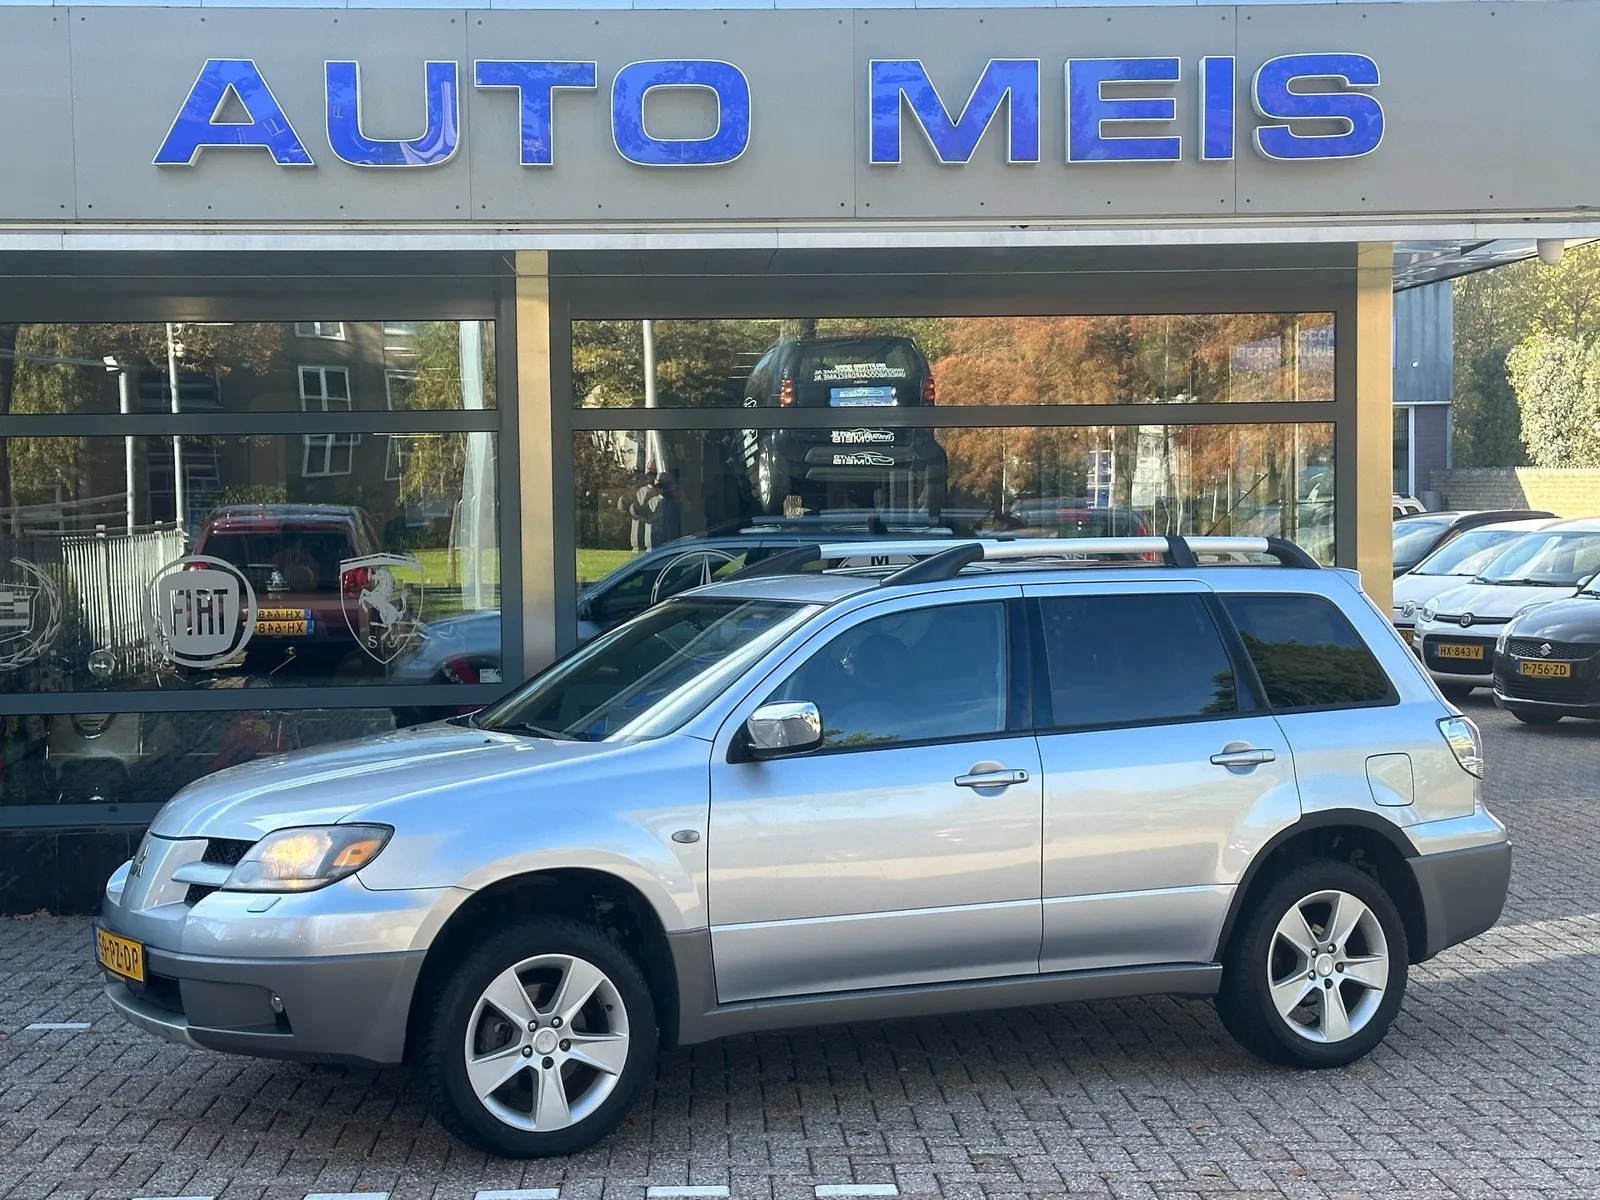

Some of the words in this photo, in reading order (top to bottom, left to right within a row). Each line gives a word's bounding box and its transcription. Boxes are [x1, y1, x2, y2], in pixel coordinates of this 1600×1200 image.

[152, 58, 751, 168] AUTO
[868, 53, 1386, 165] MEIS
[169, 589, 228, 636] FIAT
[1440, 645, 1480, 657] HX-843-V
[1522, 663, 1567, 675] P-756-ZD
